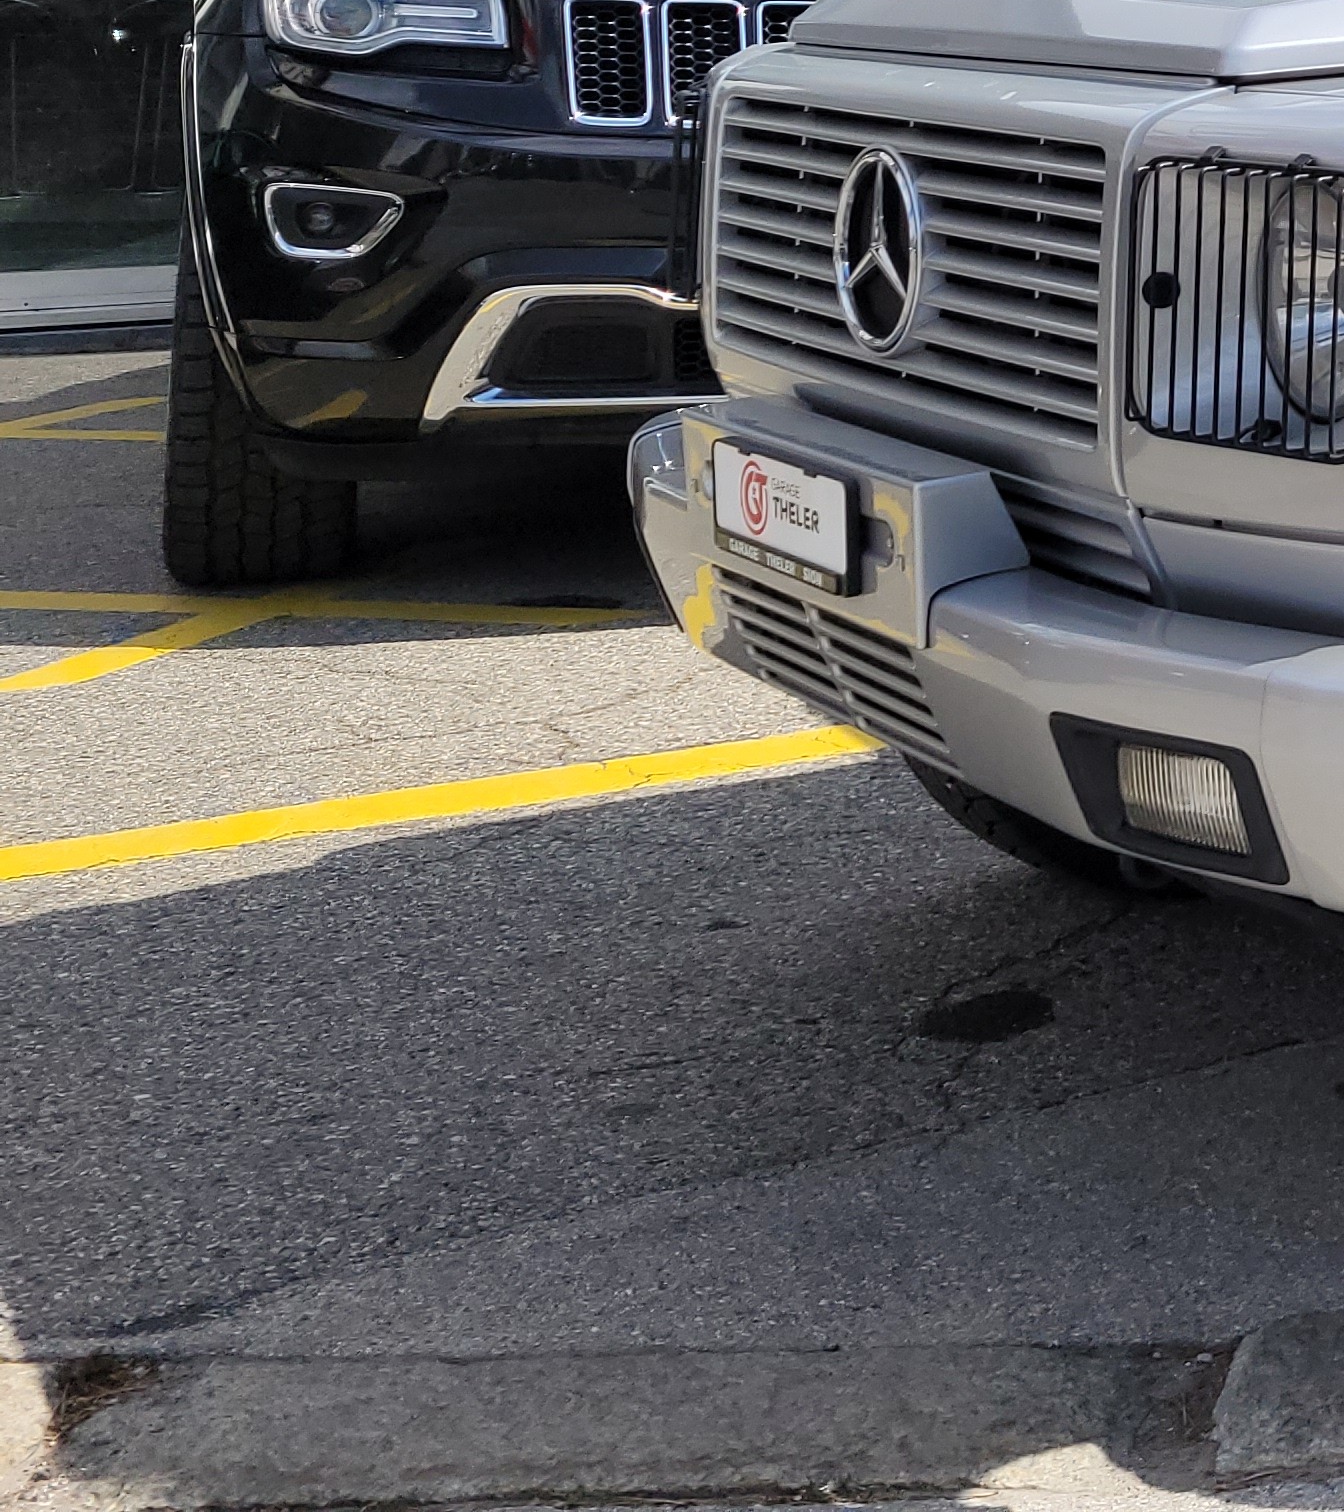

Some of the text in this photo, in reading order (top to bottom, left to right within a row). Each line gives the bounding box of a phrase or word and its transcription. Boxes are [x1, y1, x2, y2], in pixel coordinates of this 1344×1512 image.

[772, 496, 820, 535] THELER
[728, 537, 760, 563] GARAGE
[765, 551, 797, 578] THELER
